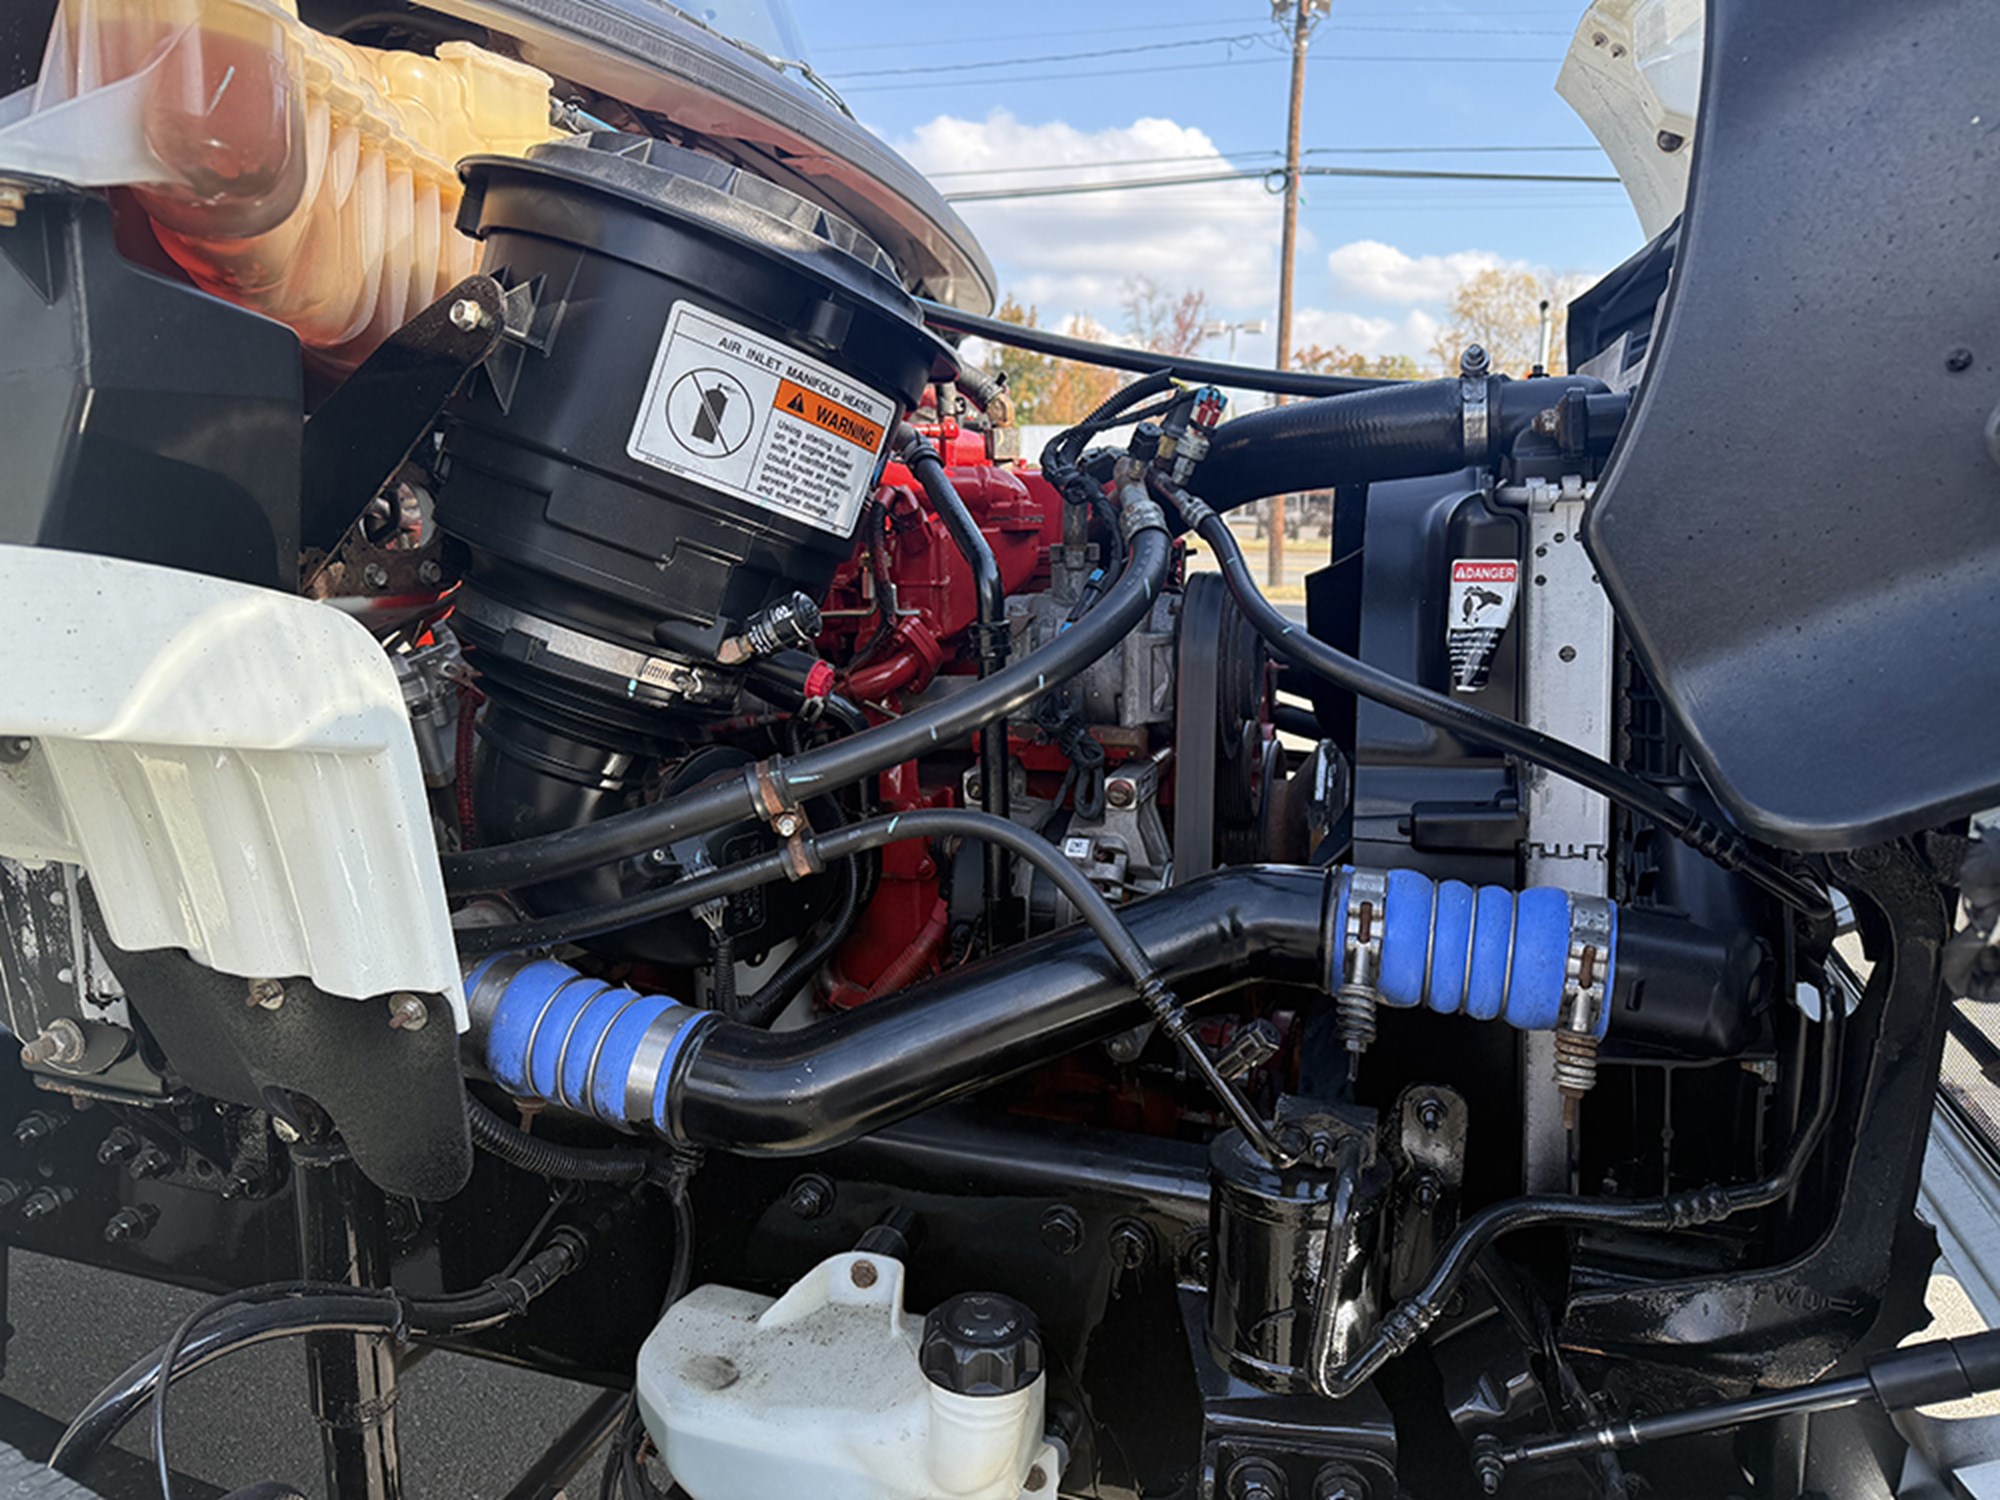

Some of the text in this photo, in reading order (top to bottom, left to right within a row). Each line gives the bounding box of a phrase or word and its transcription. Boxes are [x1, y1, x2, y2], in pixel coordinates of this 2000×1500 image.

[718, 336, 872, 414] AIR INLET MANIFOLD HEATER
[776, 419, 802, 438] Using
[804, 432, 832, 451] starting
[813, 405, 876, 446] WARNING
[770, 441, 788, 454] with
[798, 453, 828, 470] manifold
[773, 431, 785, 441] on
[788, 438, 798, 446] an
[800, 443, 824, 459] engine
[766, 452, 790, 467] could
[791, 463, 813, 476] cause
[760, 474, 840, 511] severe personal injury
[762, 463, 797, 483] possibly
[801, 478, 830, 496] resulting
[756, 483, 772, 495] and
[775, 491, 801, 507] engine
[1465, 567, 1515, 579] DANGER
